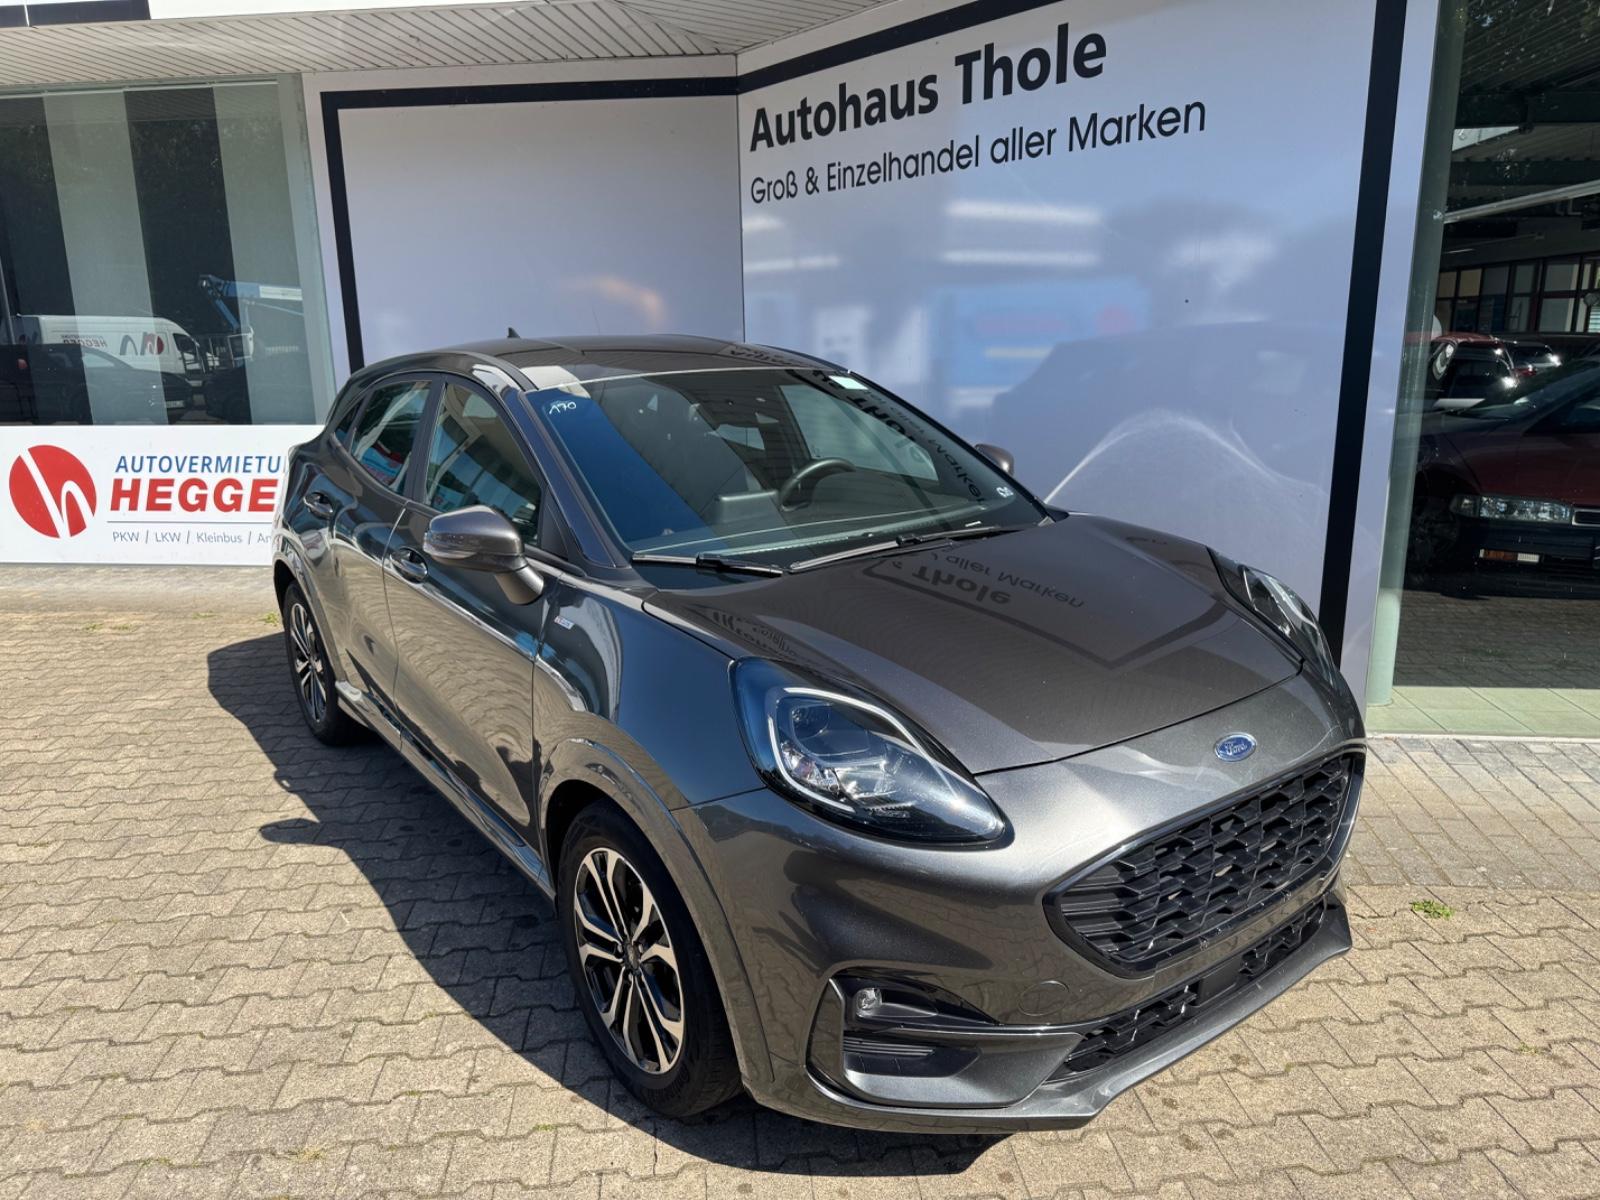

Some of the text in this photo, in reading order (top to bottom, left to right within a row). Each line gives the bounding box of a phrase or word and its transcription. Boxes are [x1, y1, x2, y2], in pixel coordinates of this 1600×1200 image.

[750, 22, 1107, 152] Autohaus Thole
[751, 101, 1206, 203] Groß & Einzelhandel aller Marken
[115, 455, 287, 474] AUTOVERMIETU
[110, 478, 279, 512] HEGGE
[112, 531, 140, 543] PKW
[155, 531, 181, 543] LKW
[196, 531, 242, 544] Kleinbus
